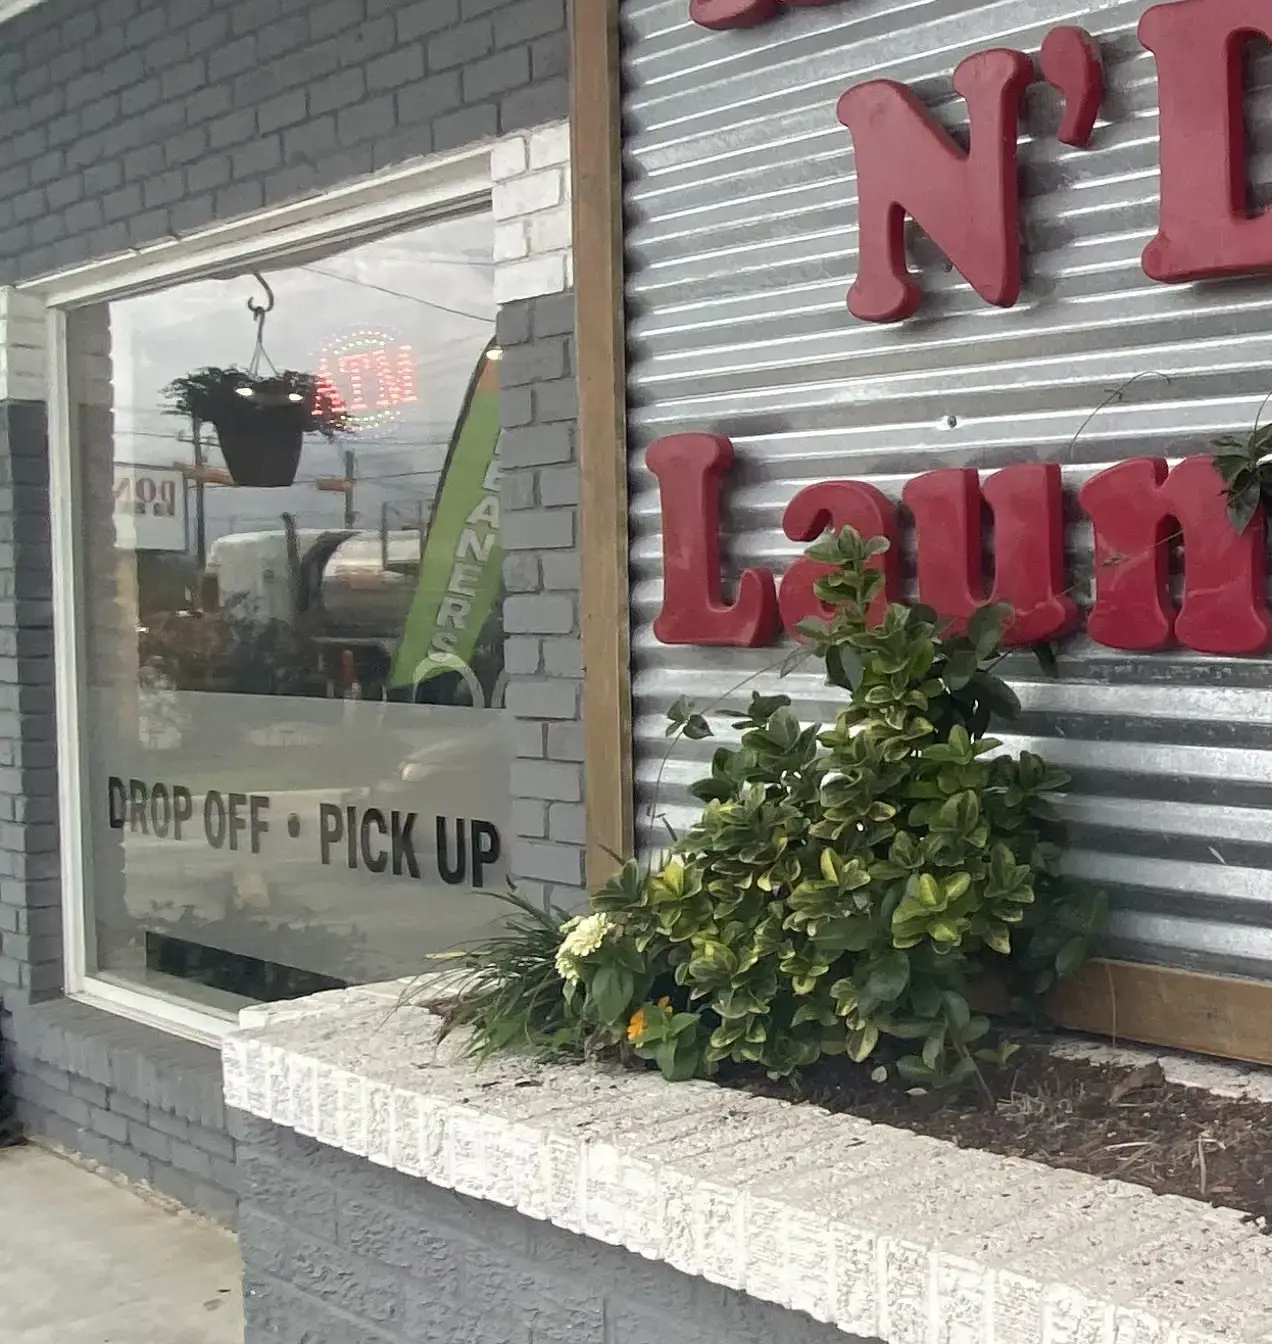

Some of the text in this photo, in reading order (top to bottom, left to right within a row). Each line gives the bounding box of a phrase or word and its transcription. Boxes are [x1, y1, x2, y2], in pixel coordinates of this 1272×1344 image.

[311, 345, 418, 415] ATM
[108, 776, 500, 888] DROP OFF PICK UP
